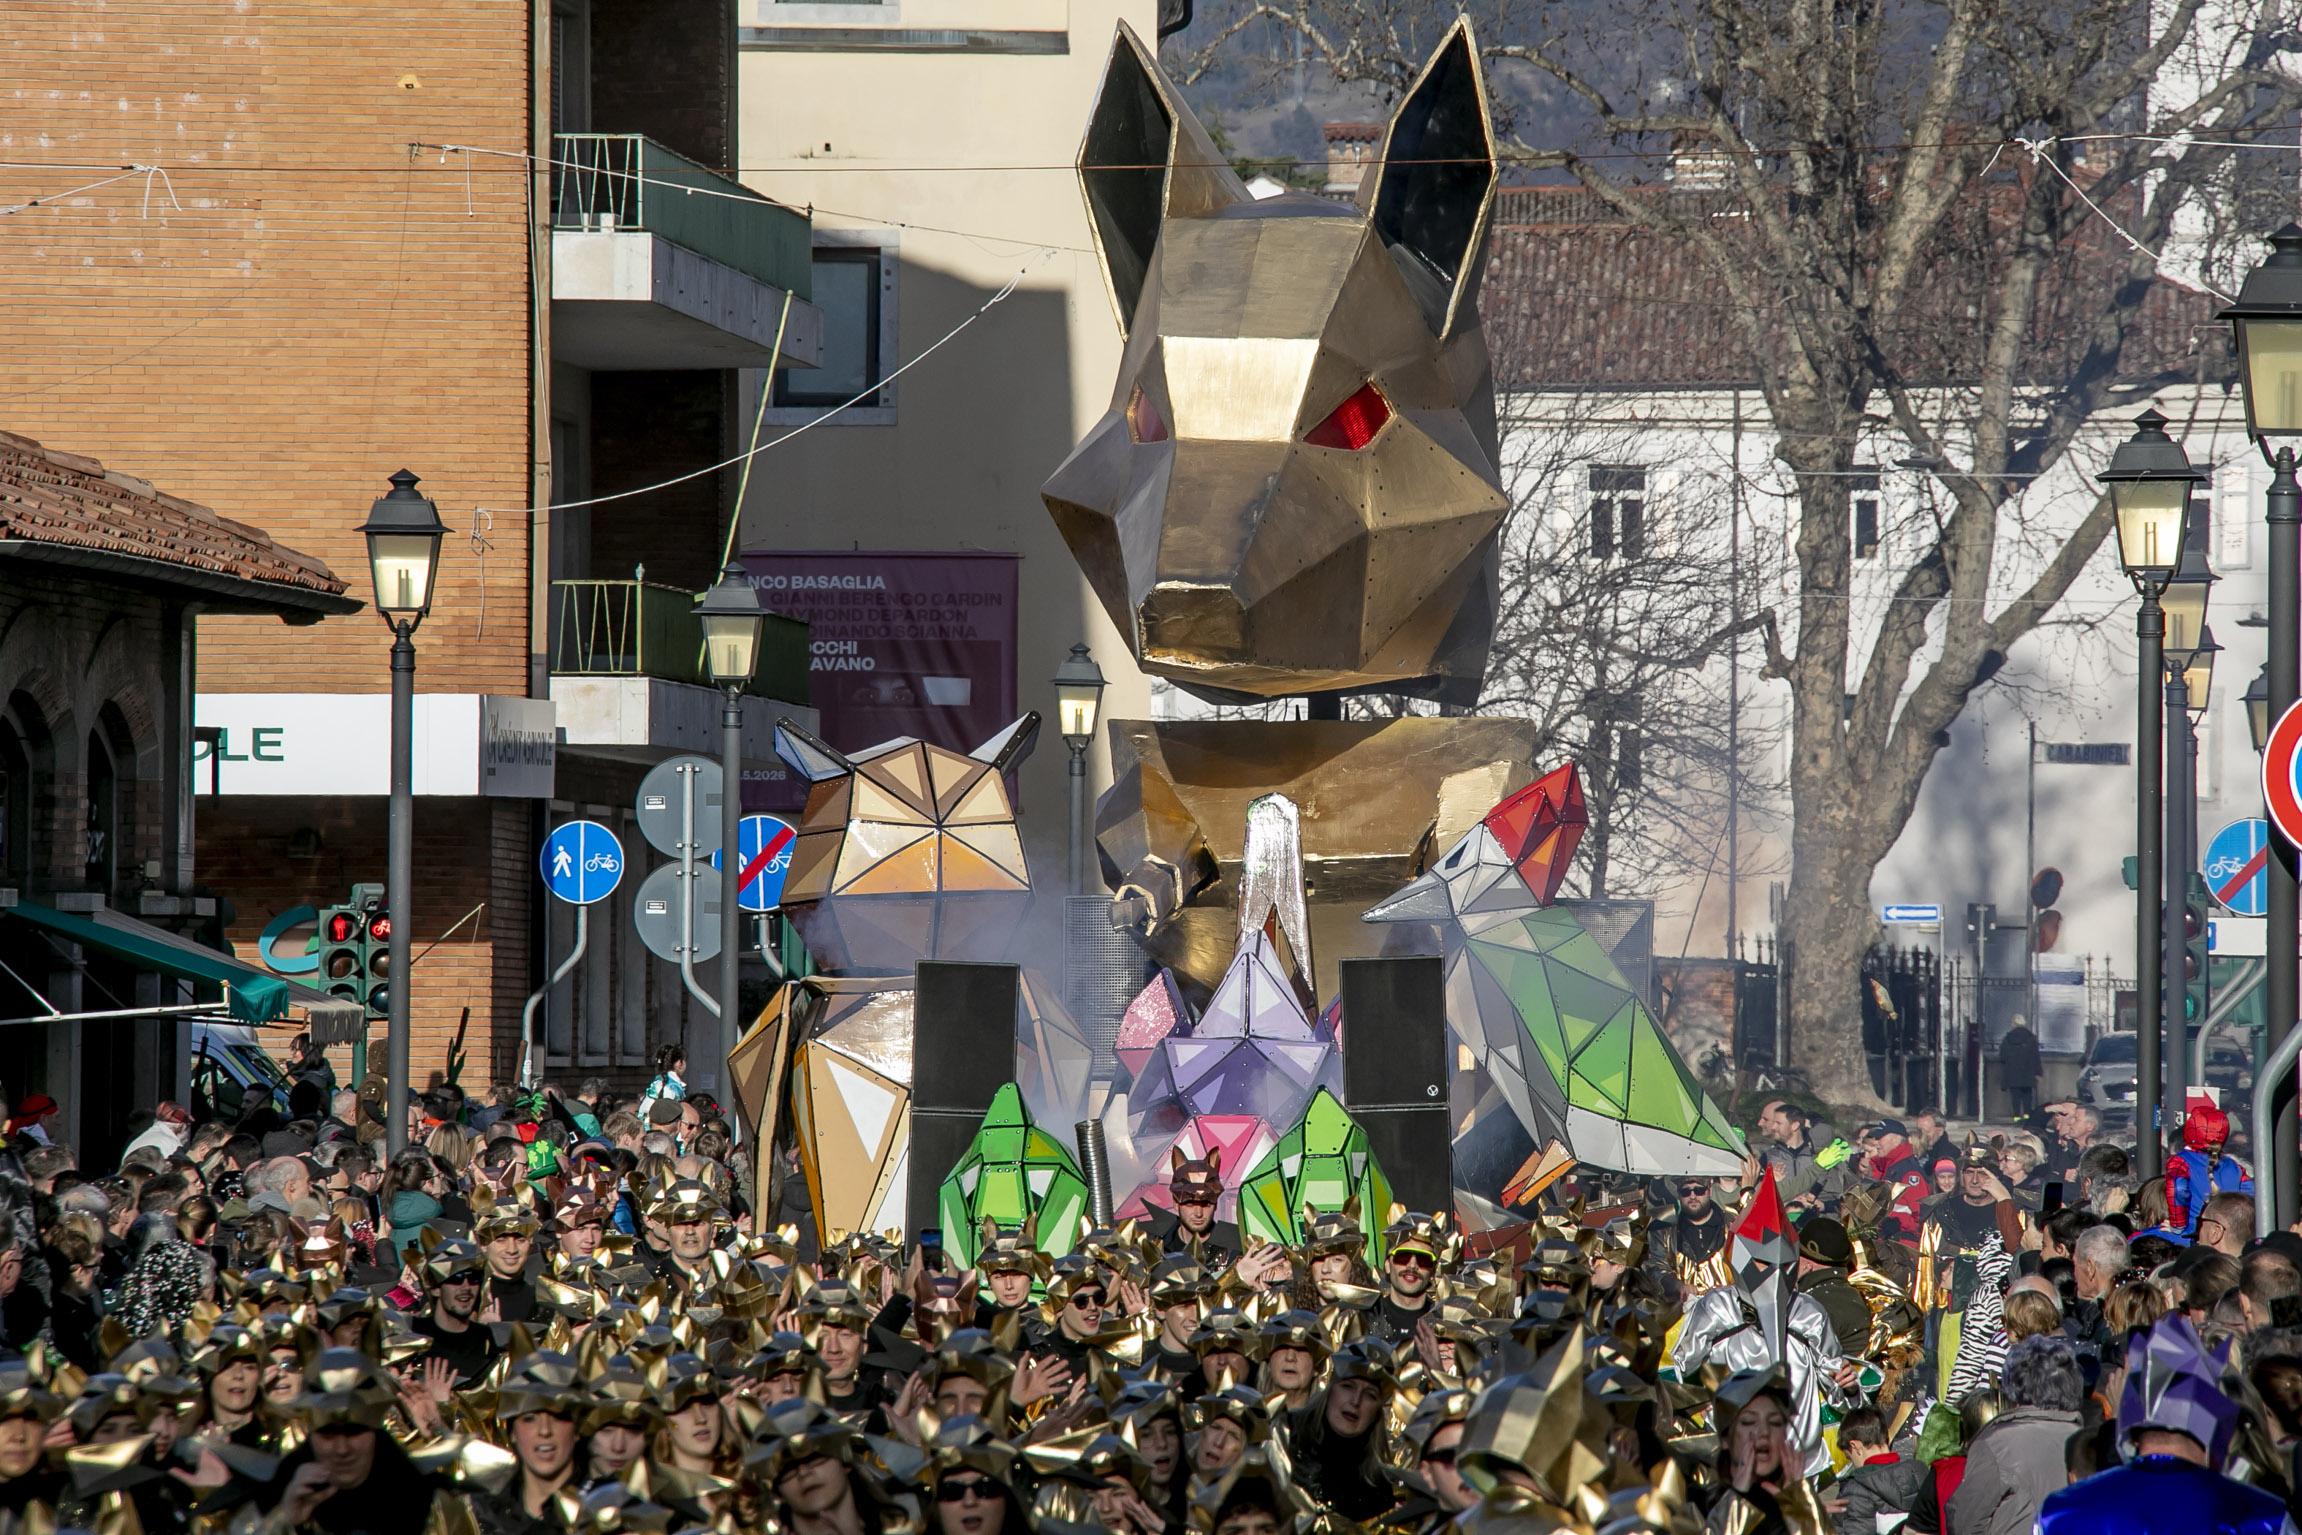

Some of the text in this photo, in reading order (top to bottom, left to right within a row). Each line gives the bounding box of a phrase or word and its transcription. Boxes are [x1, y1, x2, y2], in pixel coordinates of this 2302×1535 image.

[747, 575, 886, 590] NCO BASAGLIA
[770, 592, 1002, 607] GIANNI BERENGO GARDIN
[868, 608, 968, 622] DEPARDON
[894, 625, 978, 639] SCIANNA
[809, 641, 858, 655] CCHI
[809, 657, 876, 671] AVANO
